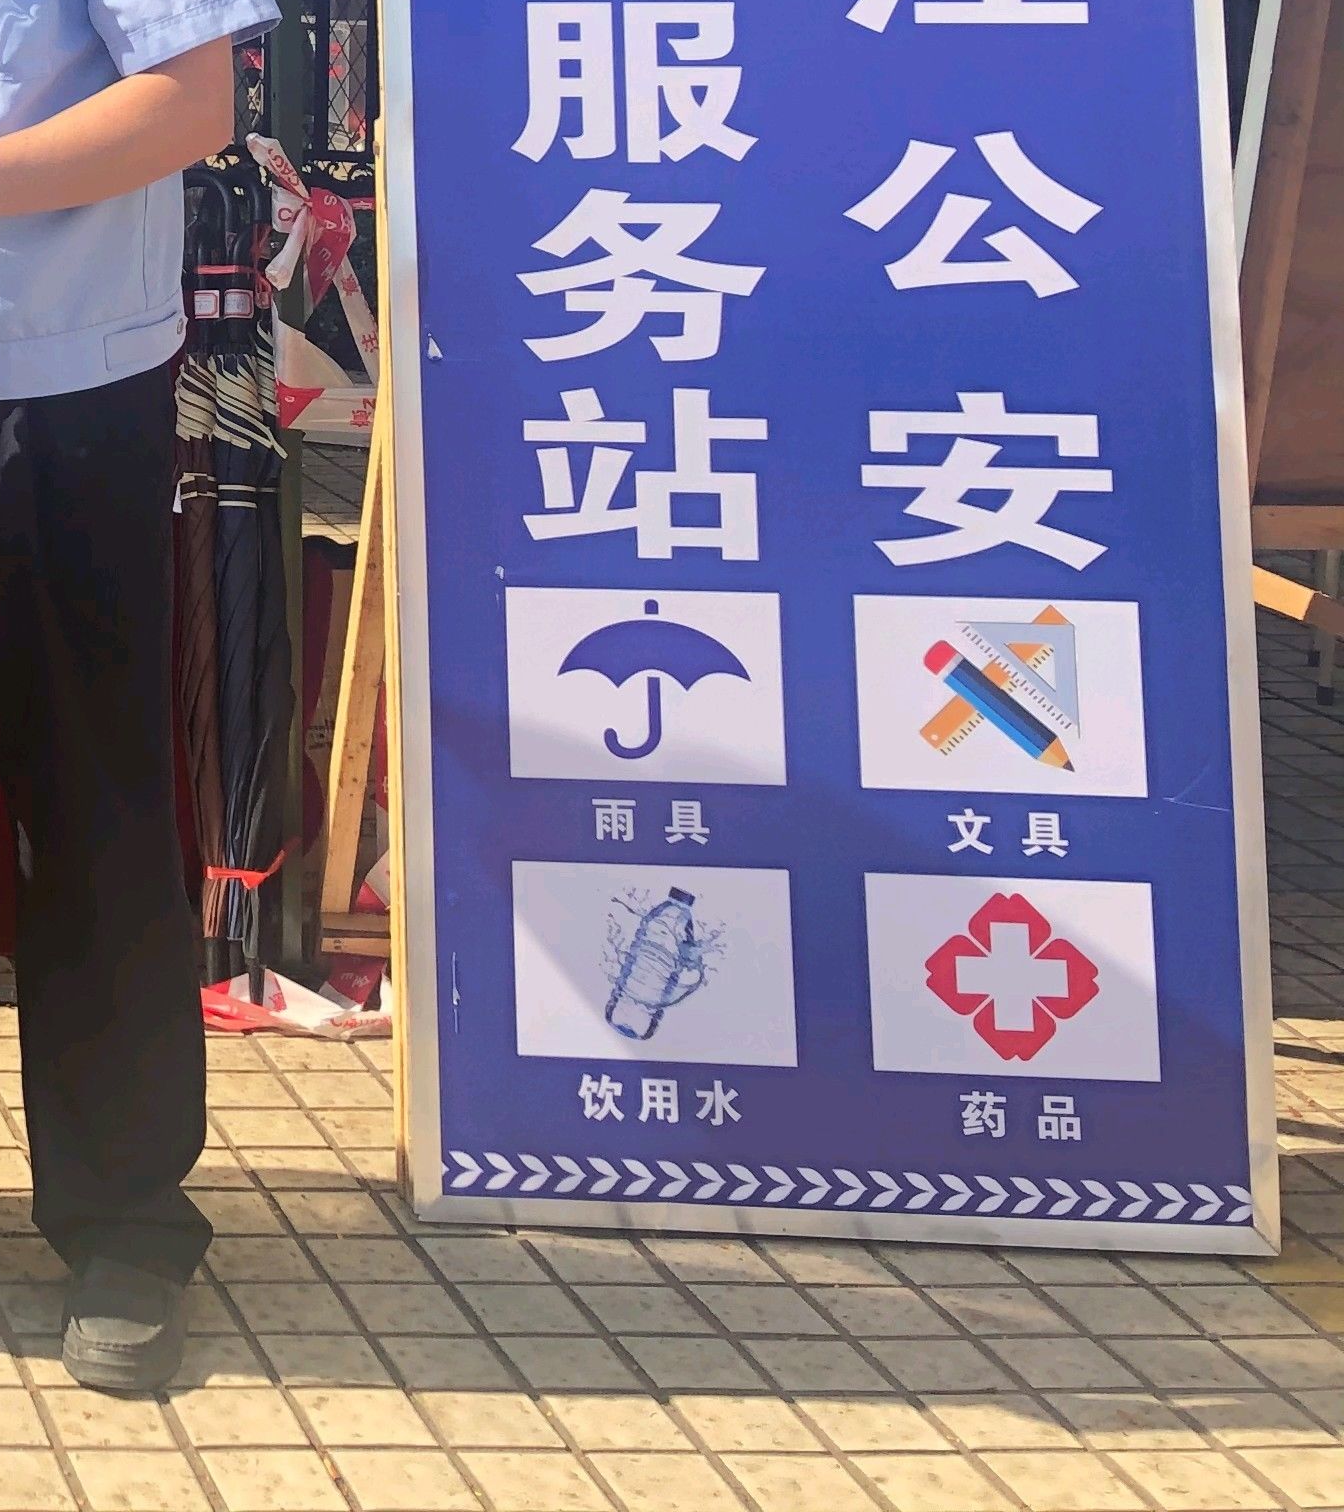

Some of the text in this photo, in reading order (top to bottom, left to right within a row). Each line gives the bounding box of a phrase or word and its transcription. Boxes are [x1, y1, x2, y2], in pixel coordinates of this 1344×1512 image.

[591, 796, 712, 849] 雨具
[947, 807, 1070, 860] 文具
[578, 1074, 742, 1127] 饮用水
[959, 1089, 1083, 1143] 药品
